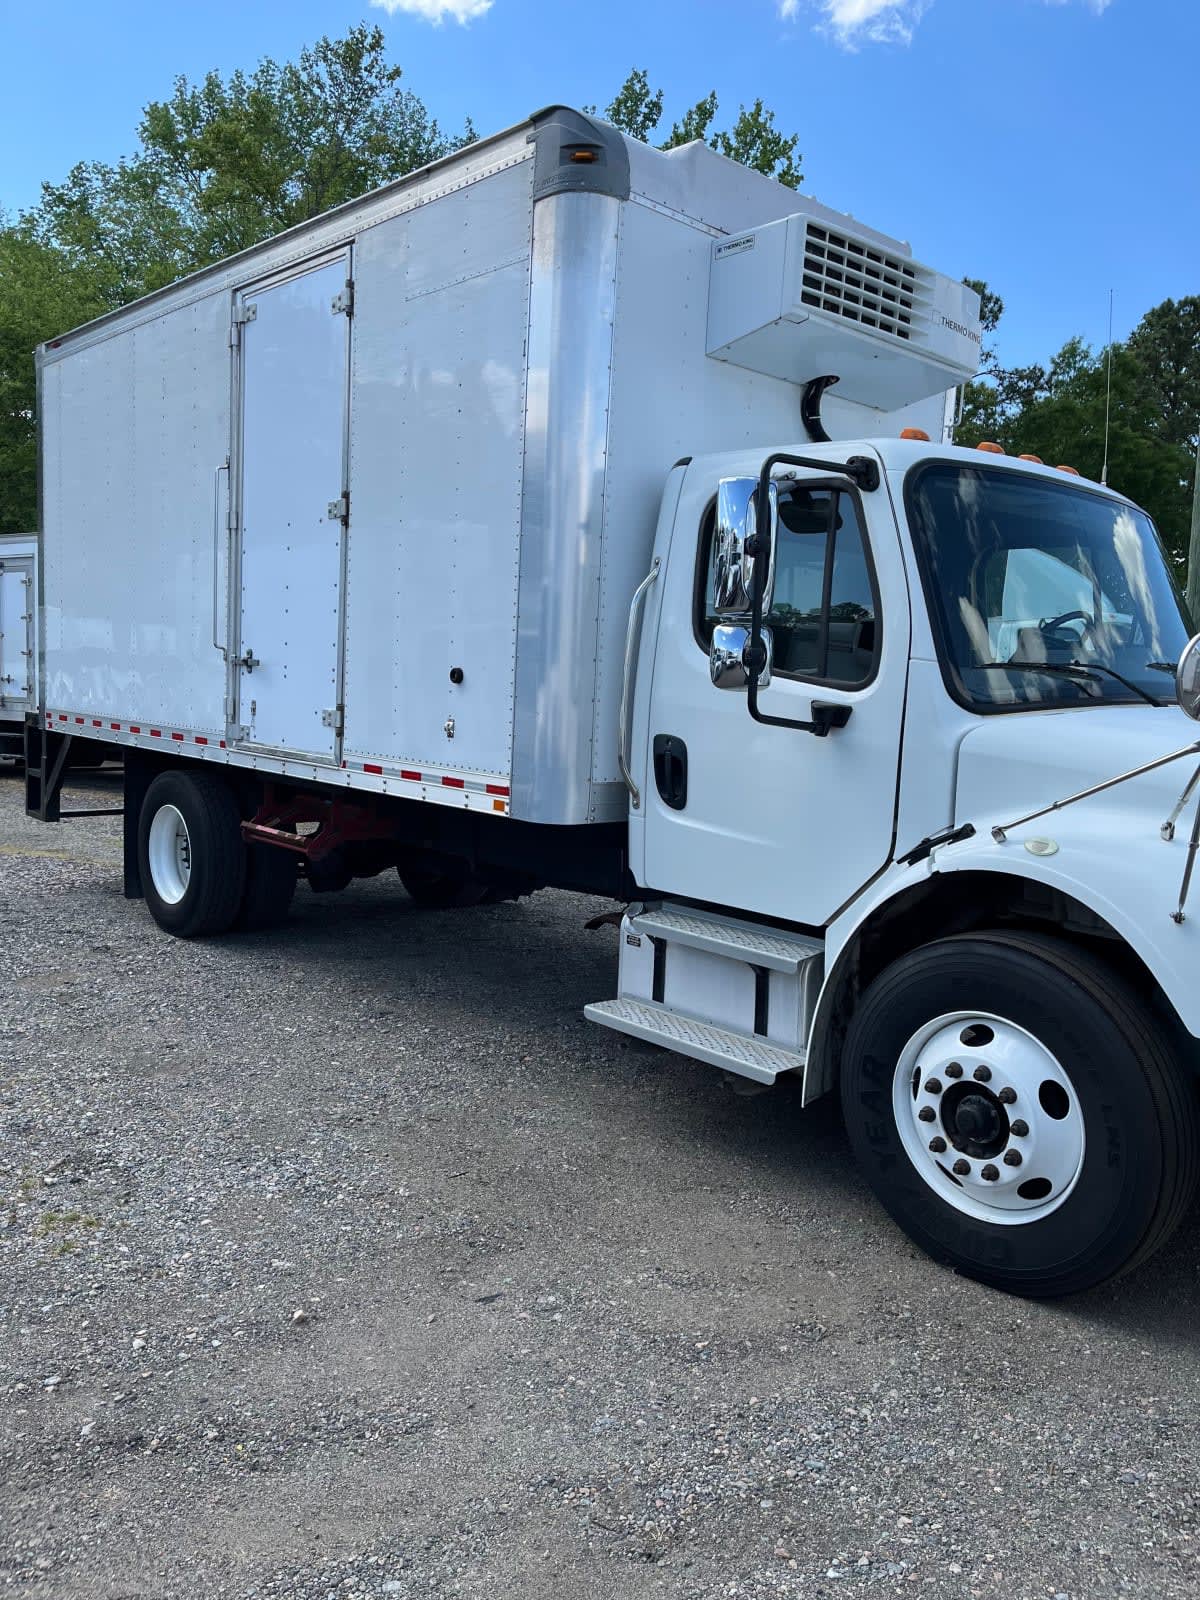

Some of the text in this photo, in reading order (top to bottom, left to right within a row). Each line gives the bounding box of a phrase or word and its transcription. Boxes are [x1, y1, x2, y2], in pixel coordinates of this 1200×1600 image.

[723, 240, 742, 251] THERMO
[942, 316, 980, 344] THERMO KING
